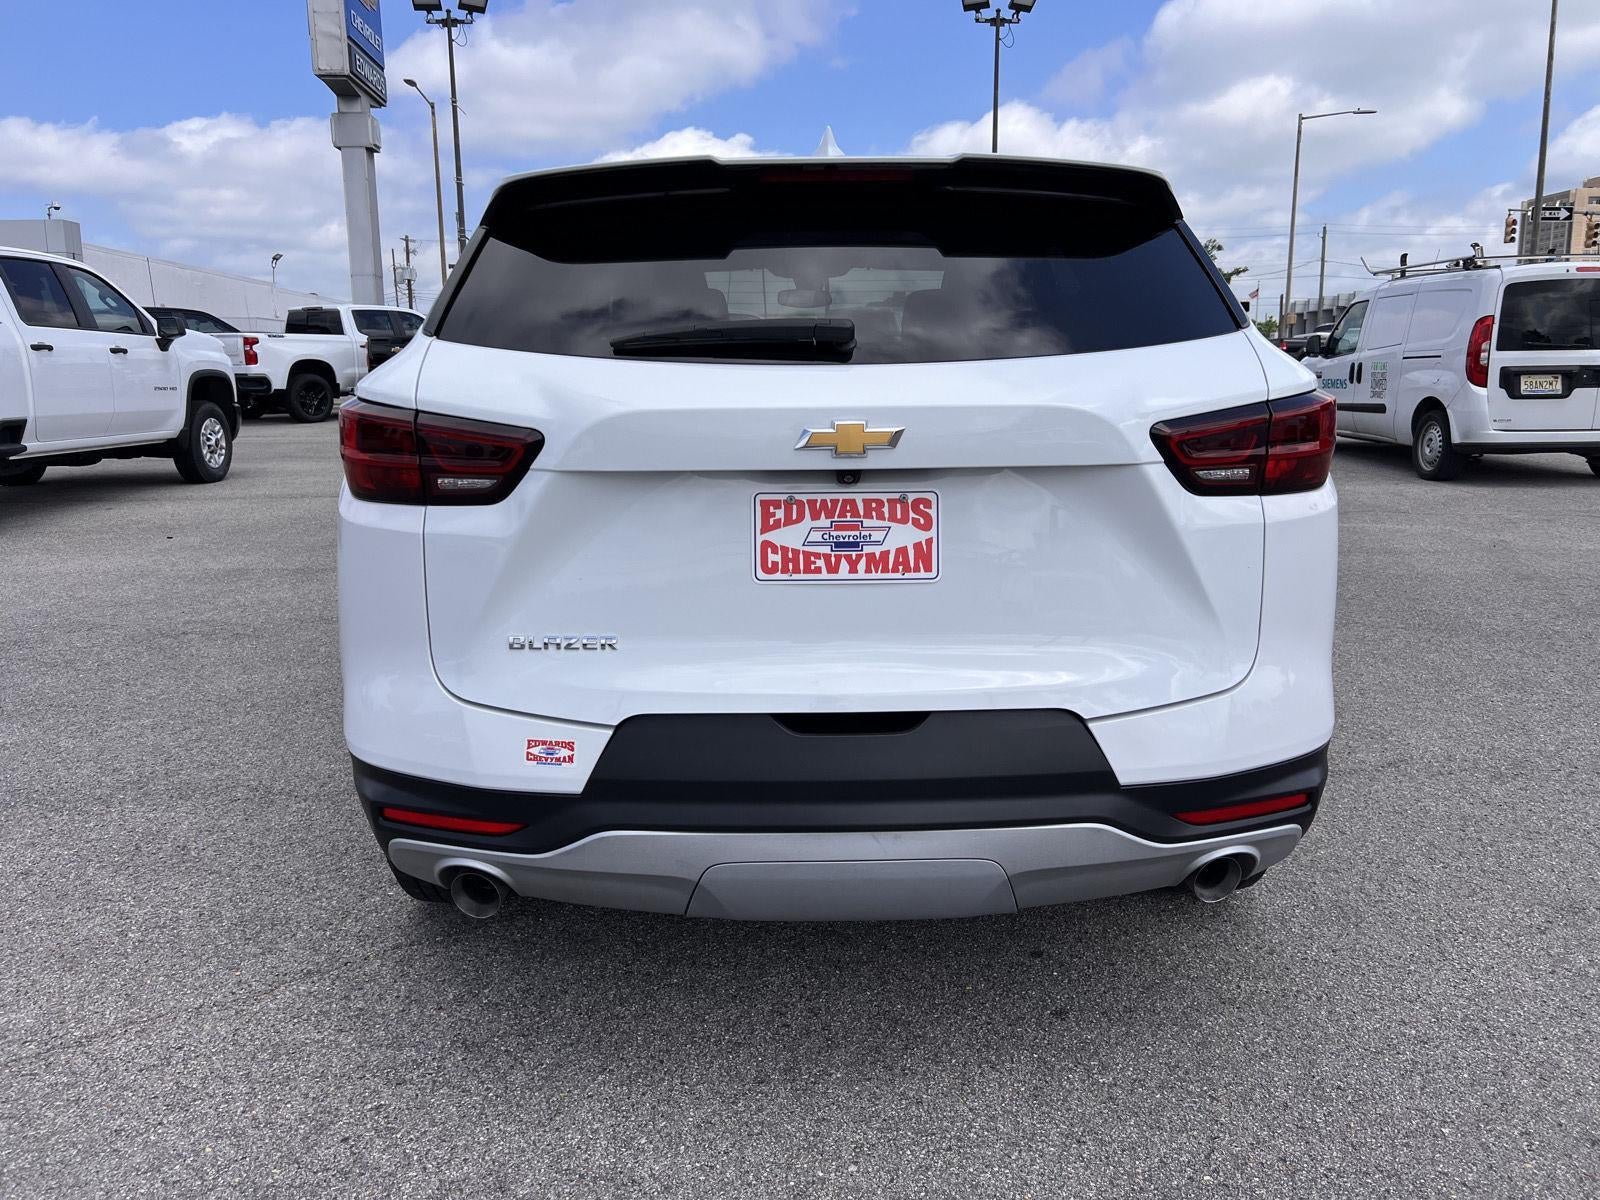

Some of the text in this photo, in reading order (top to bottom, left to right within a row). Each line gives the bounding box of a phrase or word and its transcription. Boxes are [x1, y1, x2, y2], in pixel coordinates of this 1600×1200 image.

[351, 9, 382, 53] CHEVROLET
[355, 54, 385, 95] EDWARDS
[1321, 378, 1348, 390] SIEMENS
[1523, 380, 1559, 390] 58AN2M7
[759, 496, 934, 536] EDWARDS
[821, 532, 873, 542] Chevrolet
[759, 536, 934, 575] CHEVYMAN
[508, 635, 619, 650] BLAZER
[526, 739, 575, 752] EDWARDS
[526, 751, 575, 763] CHEVYMAN
